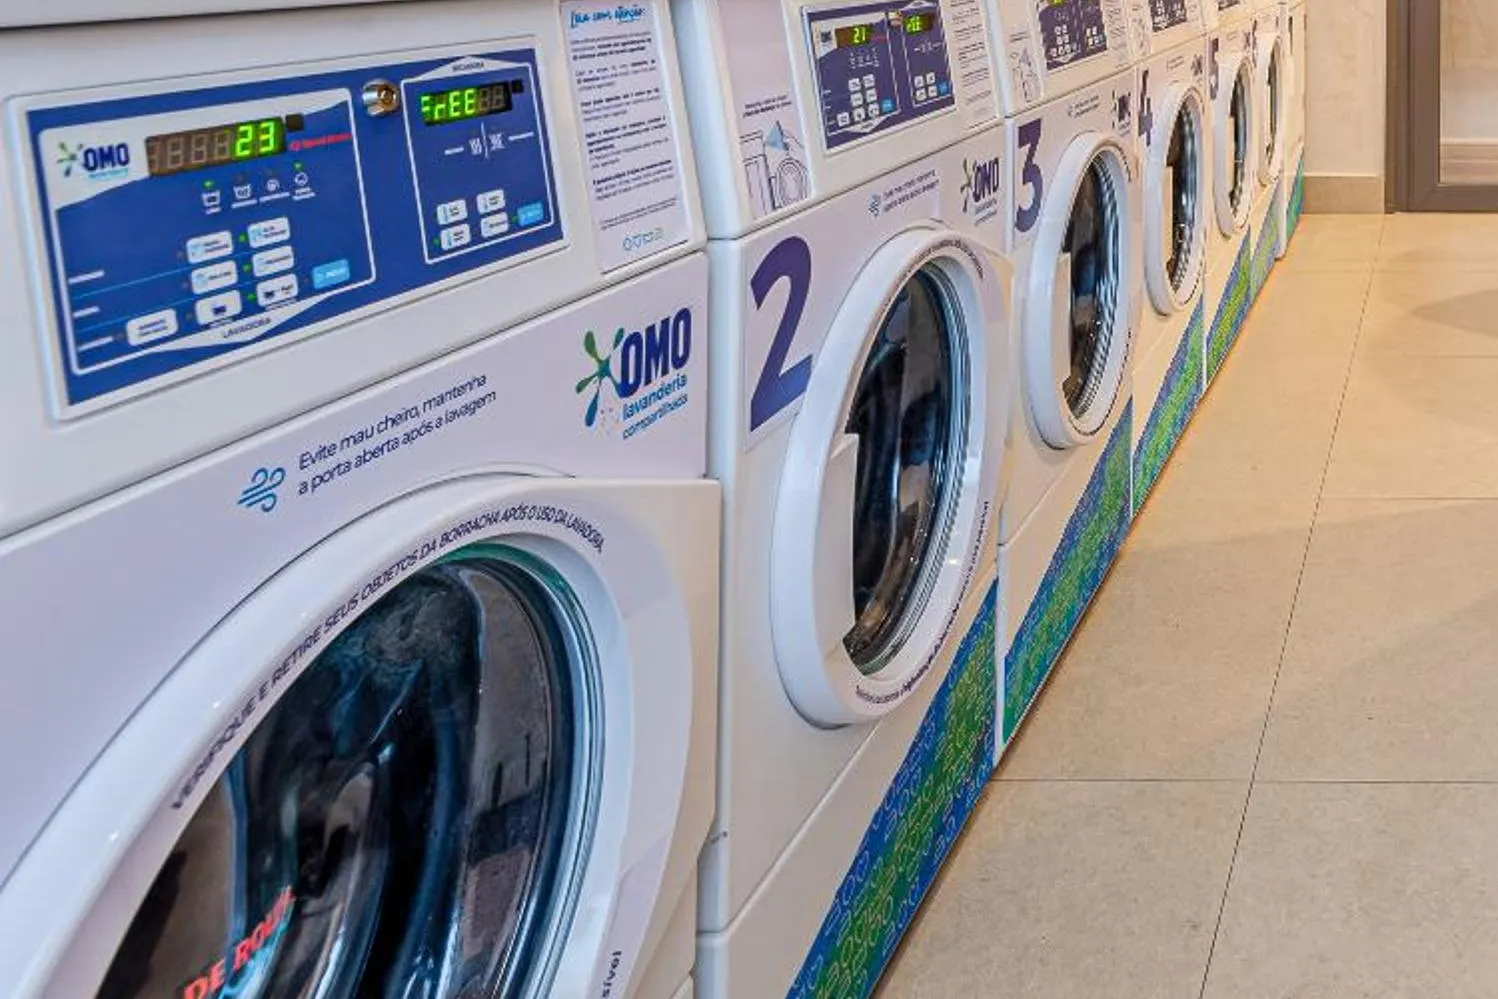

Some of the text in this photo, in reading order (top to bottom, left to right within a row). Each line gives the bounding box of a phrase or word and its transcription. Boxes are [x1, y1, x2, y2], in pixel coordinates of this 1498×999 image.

[83, 142, 130, 171] OMO
[235, 120, 275, 158] 23
[973, 157, 999, 202] OMO
[1014, 118, 1043, 232] 3
[621, 307, 692, 399] OMO
[751, 236, 813, 431] 2
[299, 391, 497, 495] a porta aberta após a lavagem
[300, 375, 487, 471] Evite mau cheiro, mantenha
[623, 373, 687, 421] lavanderia
[271, 625, 322, 689] RETIRE
[324, 593, 360, 634] SEUS
[360, 547, 420, 600] OBJETOS
[419, 537, 437, 561] DA
[500, 502, 526, 522] APÓS
